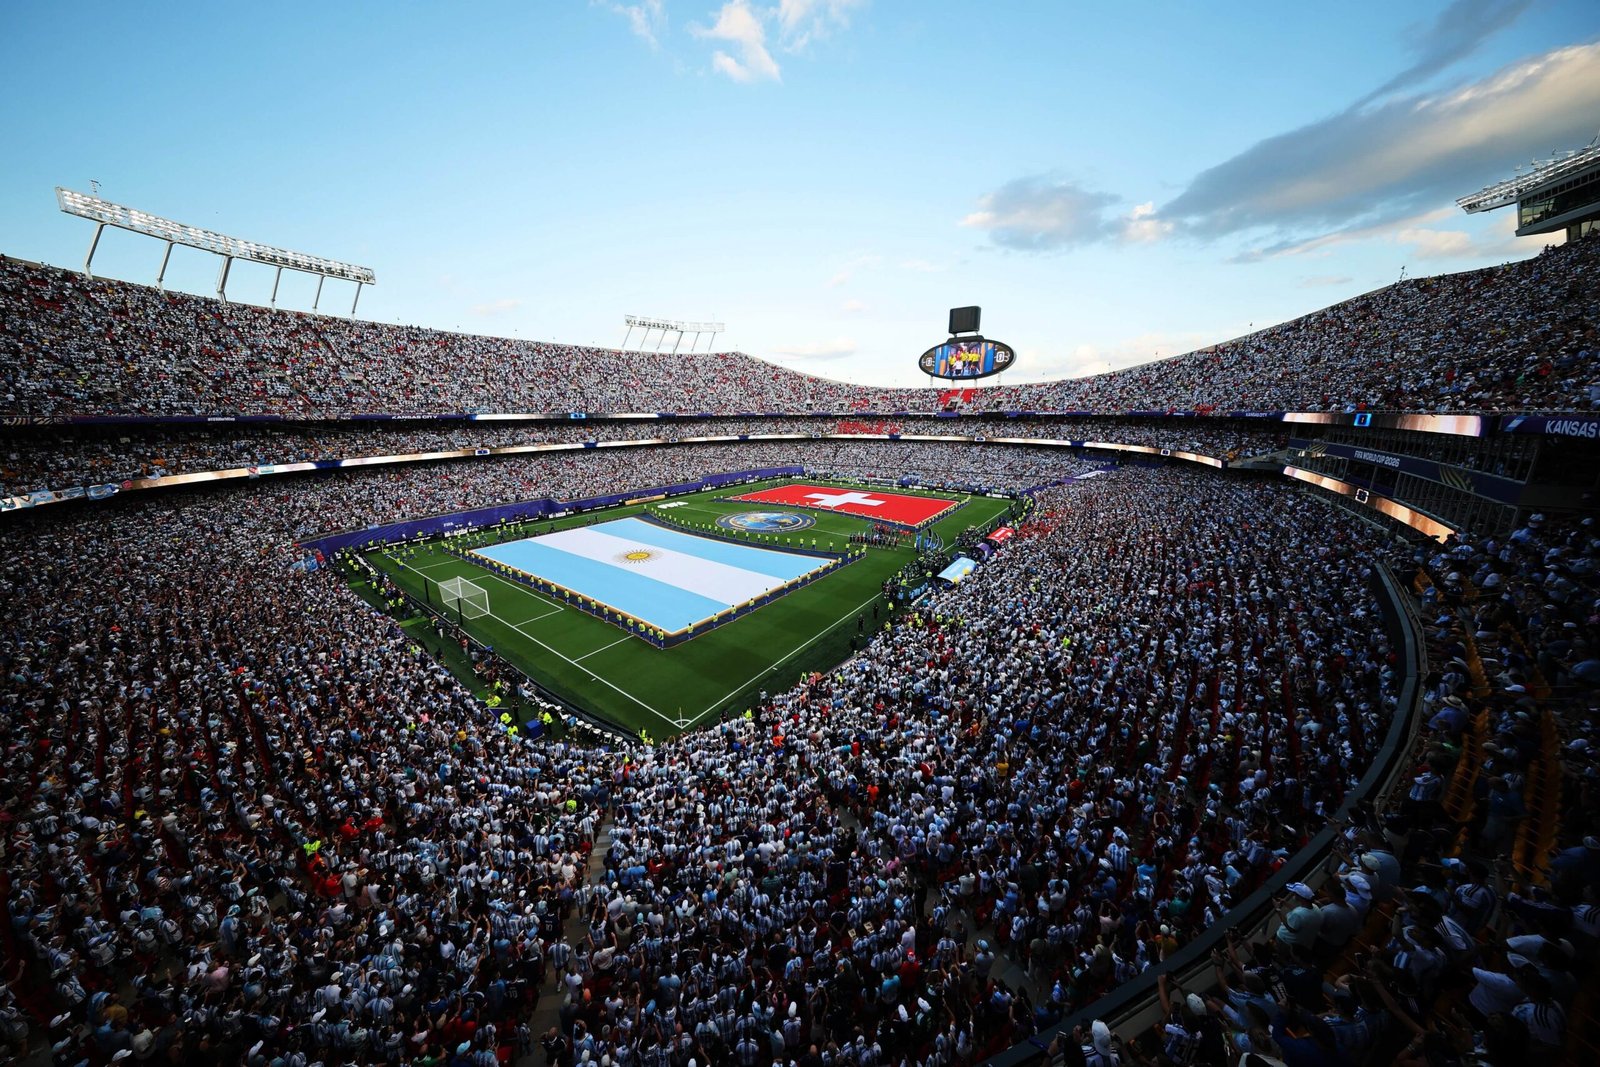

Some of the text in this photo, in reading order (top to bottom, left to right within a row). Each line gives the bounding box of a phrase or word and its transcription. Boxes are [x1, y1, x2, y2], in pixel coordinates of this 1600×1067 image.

[1545, 420, 1598, 438] KANSAS
[1354, 450, 1400, 468] FIFA WORLD CUP 2026
